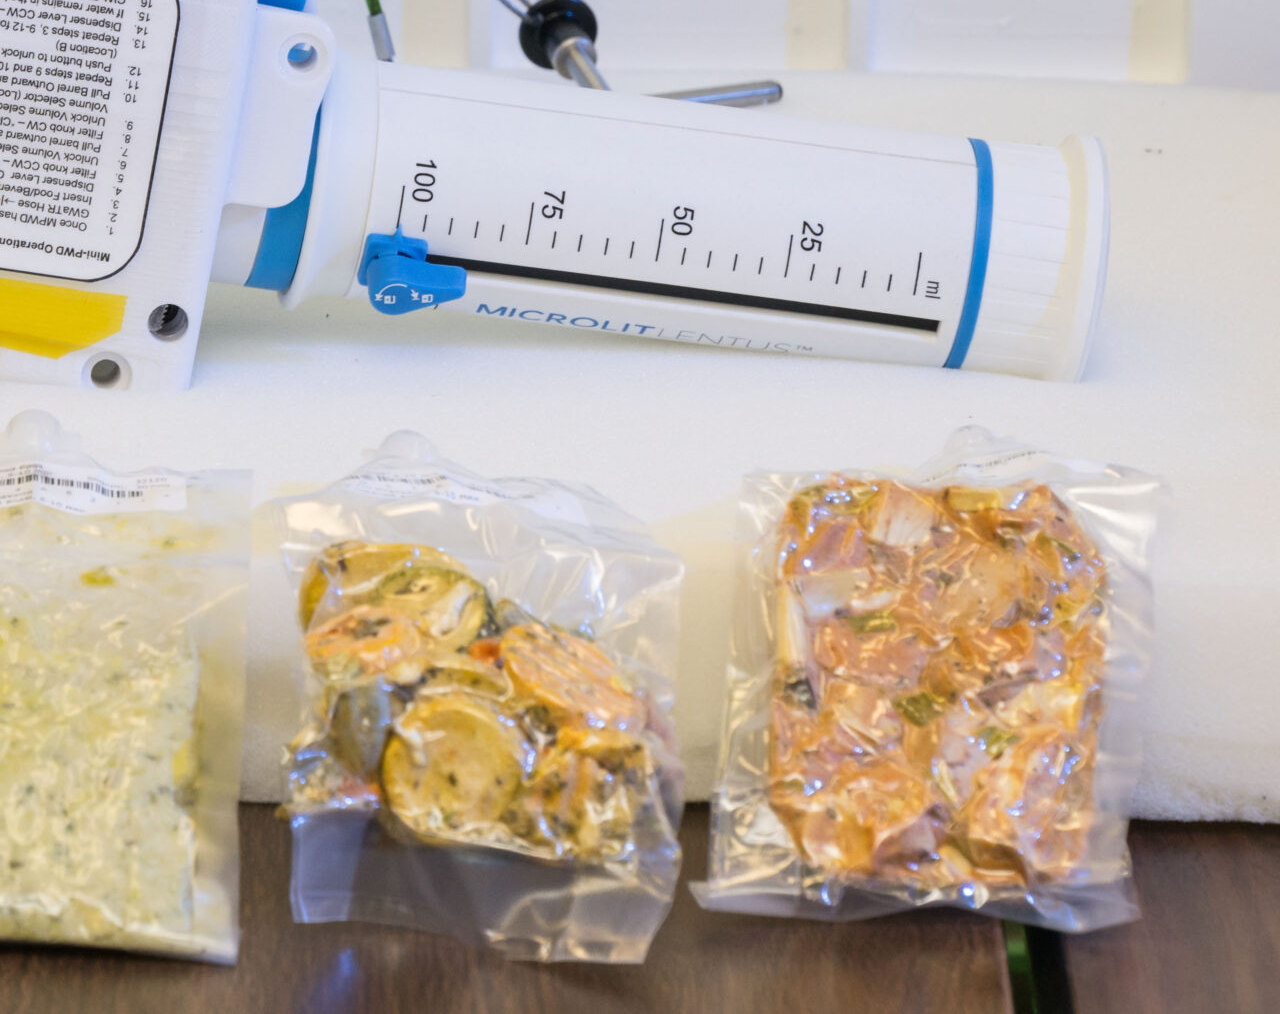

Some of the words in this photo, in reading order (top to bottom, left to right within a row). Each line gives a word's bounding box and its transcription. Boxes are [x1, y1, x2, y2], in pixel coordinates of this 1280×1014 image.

[11, 62, 34, 73] and
[34, 65, 43, 77] 9
[43, 66, 73, 80] steps
[9, 75, 55, 92] Outward
[74, 71, 113, 87] Repeat
[55, 82, 89, 97] Barrel
[89, 87, 111, 100] Pull
[22, 92, 67, 108] Selector
[67, 98, 108, 114] Volume
[27, 105, 68, 121] Volume
[69, 112, 106, 127] Unlock
[4, 129, 47, 143] outward
[47, 136, 80, 150] barrel
[20, 145, 61, 161] Volume
[80, 140, 102, 154] Pull
[62, 151, 99, 167] Unlock
[412, 159, 437, 203] 100
[16, 198, 45, 212] Hose
[61, 191, 93, 206] Insert
[540, 190, 567, 220] 75
[46, 203, 90, 219] GWaTR
[18, 212, 57, 228] MPWD
[58, 218, 88, 232] Once
[670, 205, 696, 237] 50
[799, 220, 825, 253] 25
[54, 244, 111, 263] Mini-PWD
[924, 280, 942, 300] ml
